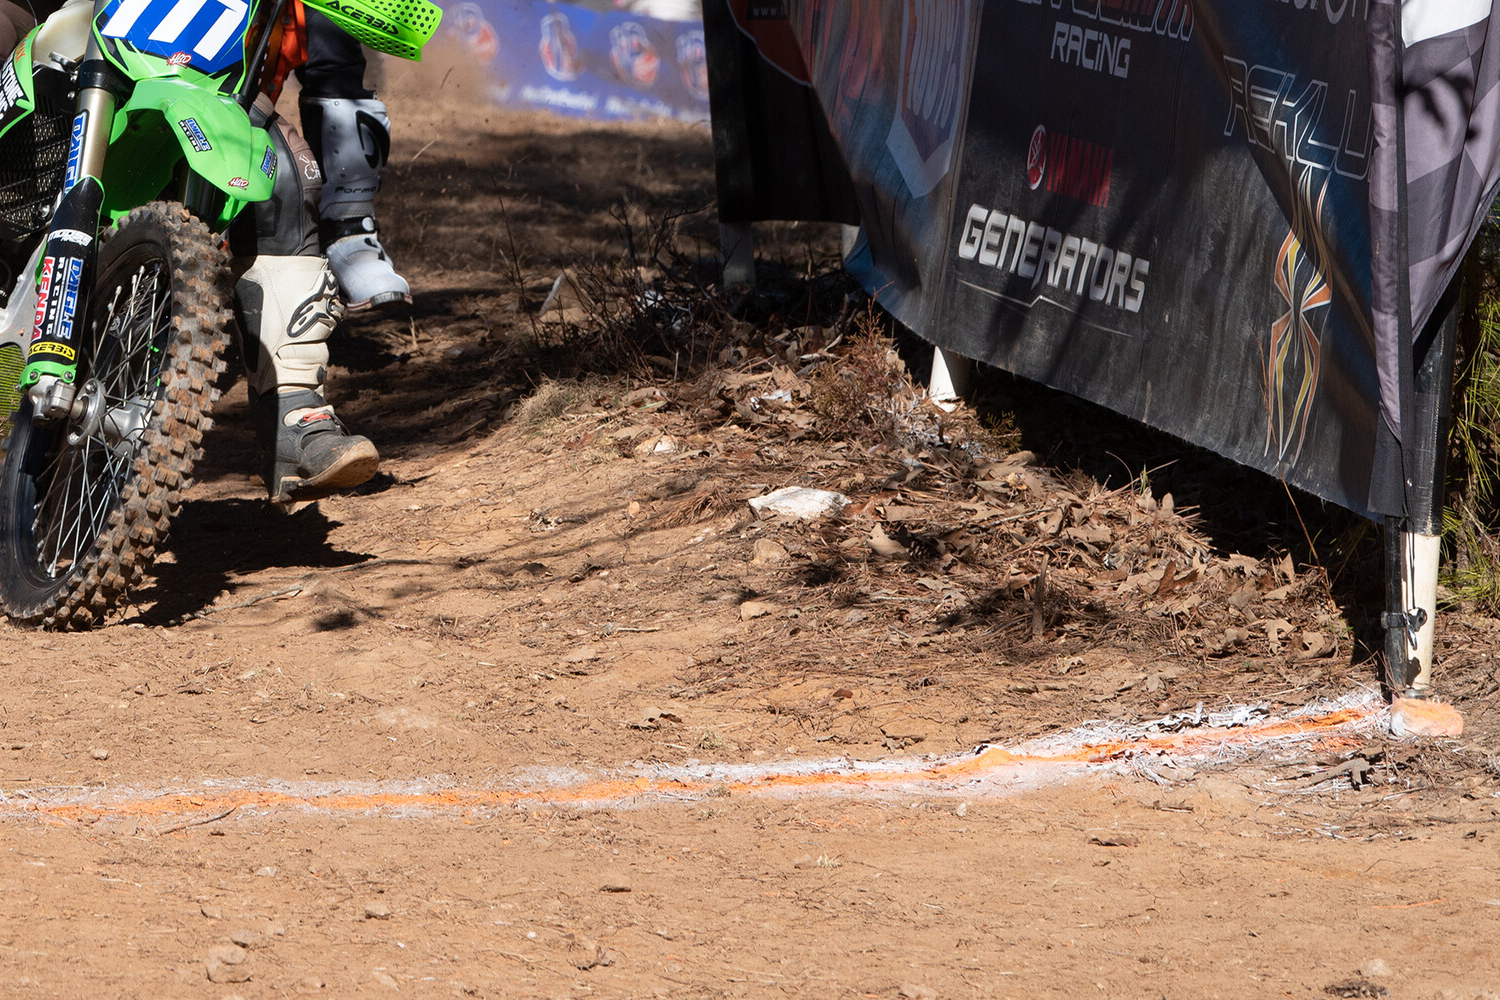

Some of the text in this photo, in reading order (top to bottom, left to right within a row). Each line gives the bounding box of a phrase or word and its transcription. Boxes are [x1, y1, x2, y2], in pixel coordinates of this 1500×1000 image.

[1223, 55, 1375, 182] REKLU
[30, 256, 56, 341] KENDA
[45, 256, 66, 336] RACING
[56, 256, 84, 340] DAIGLE
